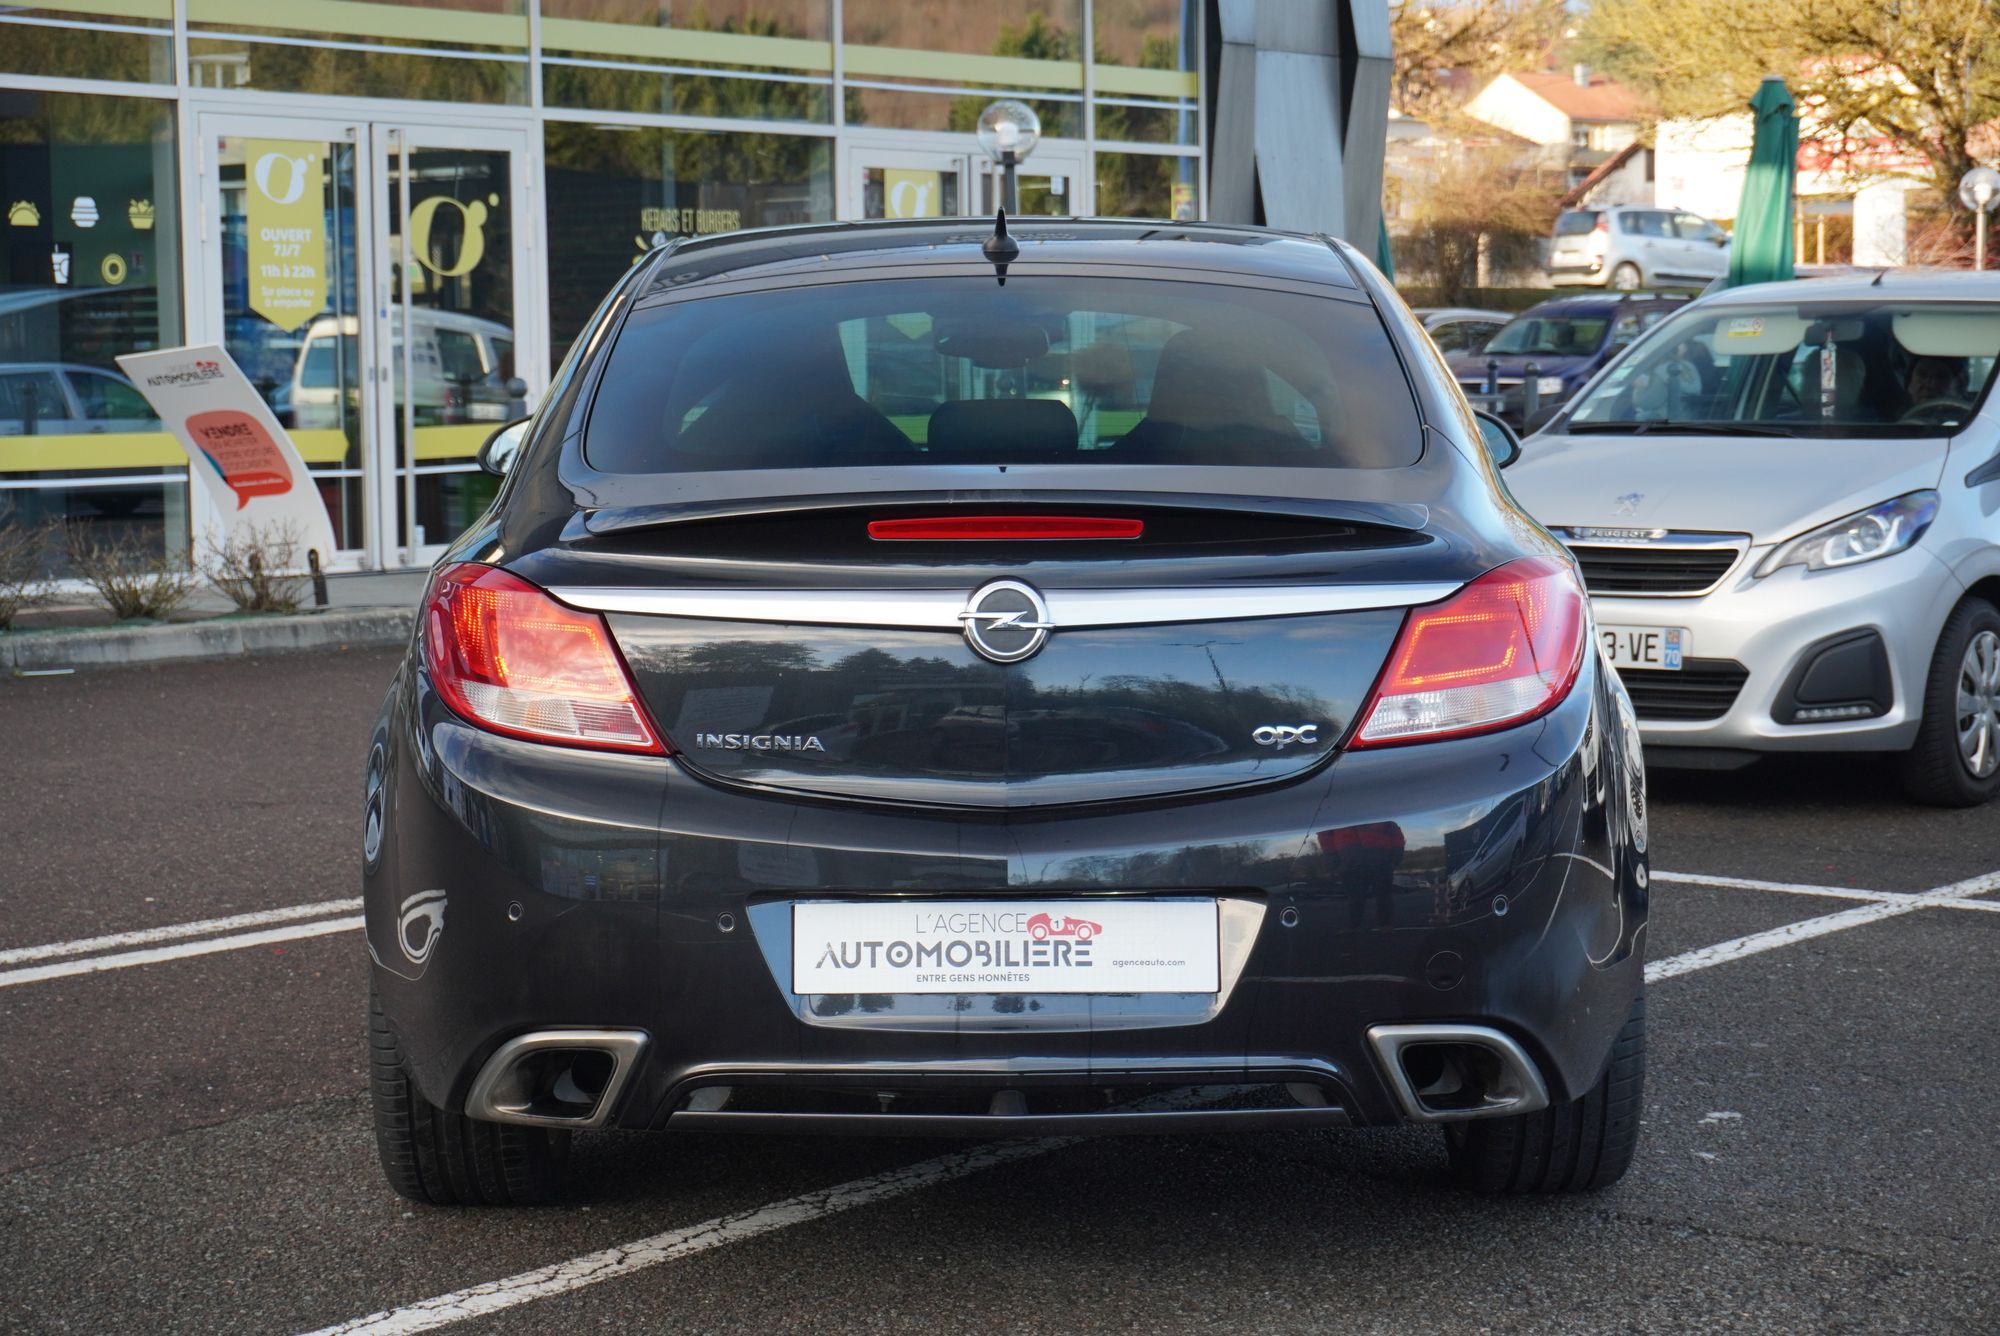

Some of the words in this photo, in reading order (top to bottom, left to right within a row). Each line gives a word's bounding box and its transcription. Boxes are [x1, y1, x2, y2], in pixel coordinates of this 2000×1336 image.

[641, 208, 680, 232] KEBABS
[681, 208, 694, 232] ET
[696, 209, 741, 232] BURGERS
[261, 227, 312, 241] OUVERT
[261, 264, 280, 278] 11h
[292, 265, 315, 278] 22h
[276, 286, 301, 298] place
[199, 422, 253, 438] VENDRE
[1589, 528, 1647, 538] PEUGEOT
[1665, 649, 1679, 664] 70
[696, 733, 825, 752] INSIGNIA
[915, 912, 1027, 934] L'AGENCE
[1112, 959, 1186, 967] agenceauto.com
[916, 973, 947, 983] ENTRE
[949, 973, 976, 983] GENS
[978, 971, 1031, 983] HONNÊTES
